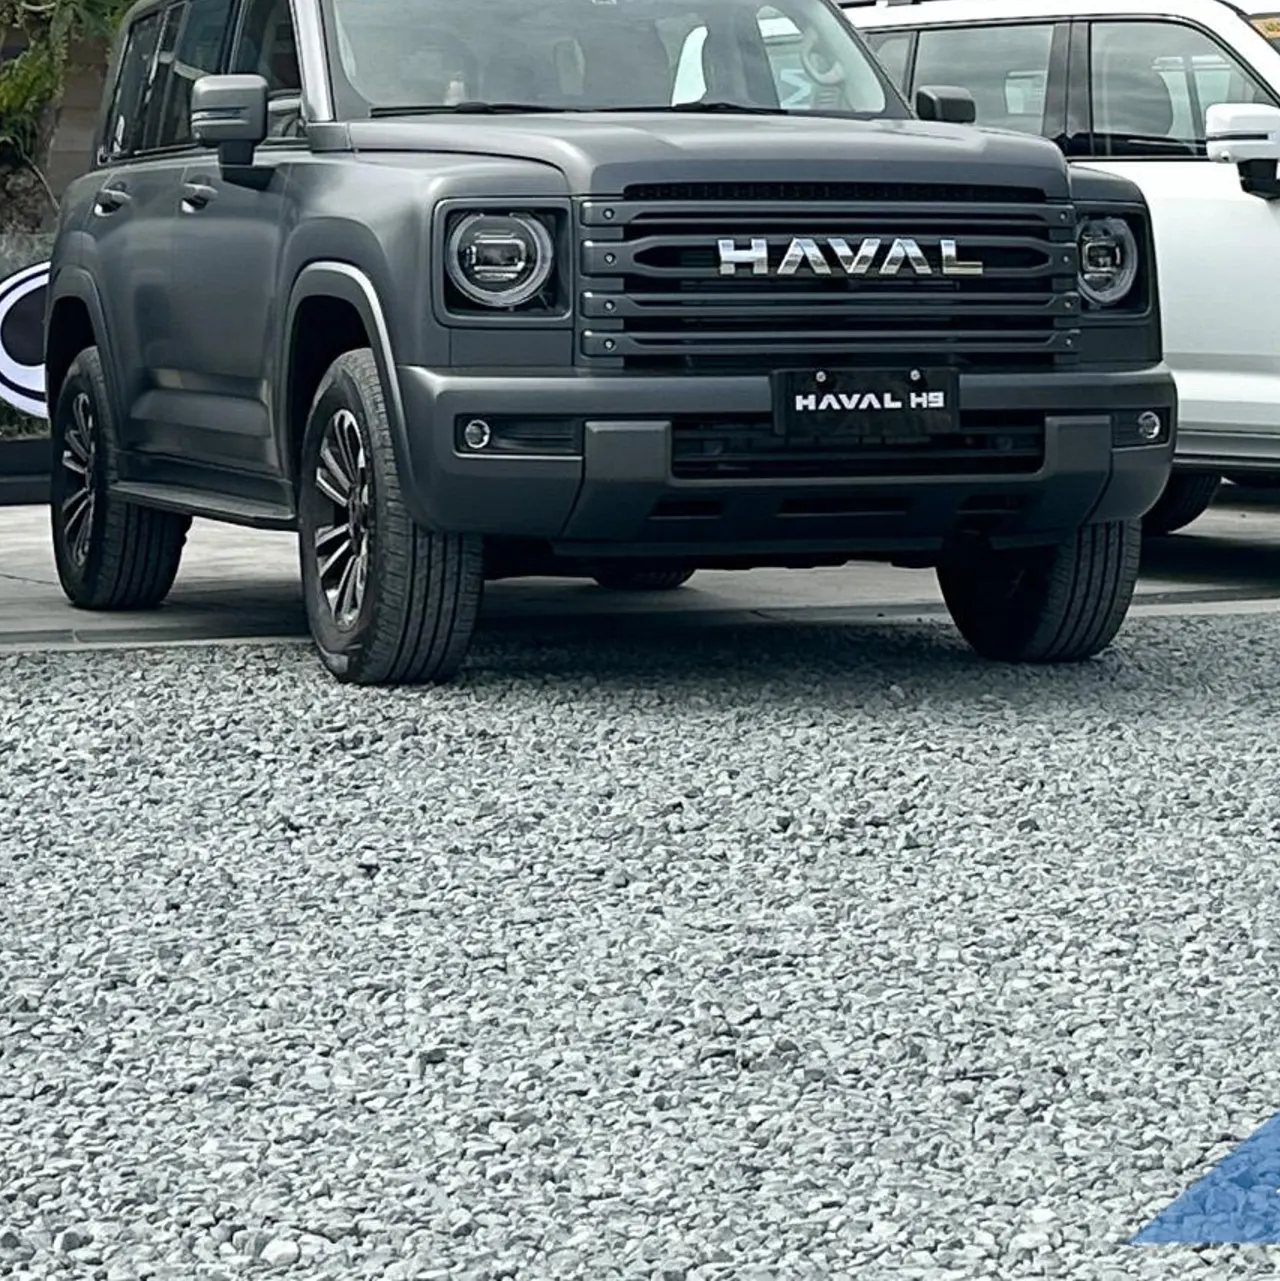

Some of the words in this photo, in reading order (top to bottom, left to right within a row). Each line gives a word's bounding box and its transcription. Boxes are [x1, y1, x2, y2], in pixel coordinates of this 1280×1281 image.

[718, 238, 983, 274] HAVAL
[795, 393, 902, 411] HAVAL
[910, 392, 944, 408] H9
